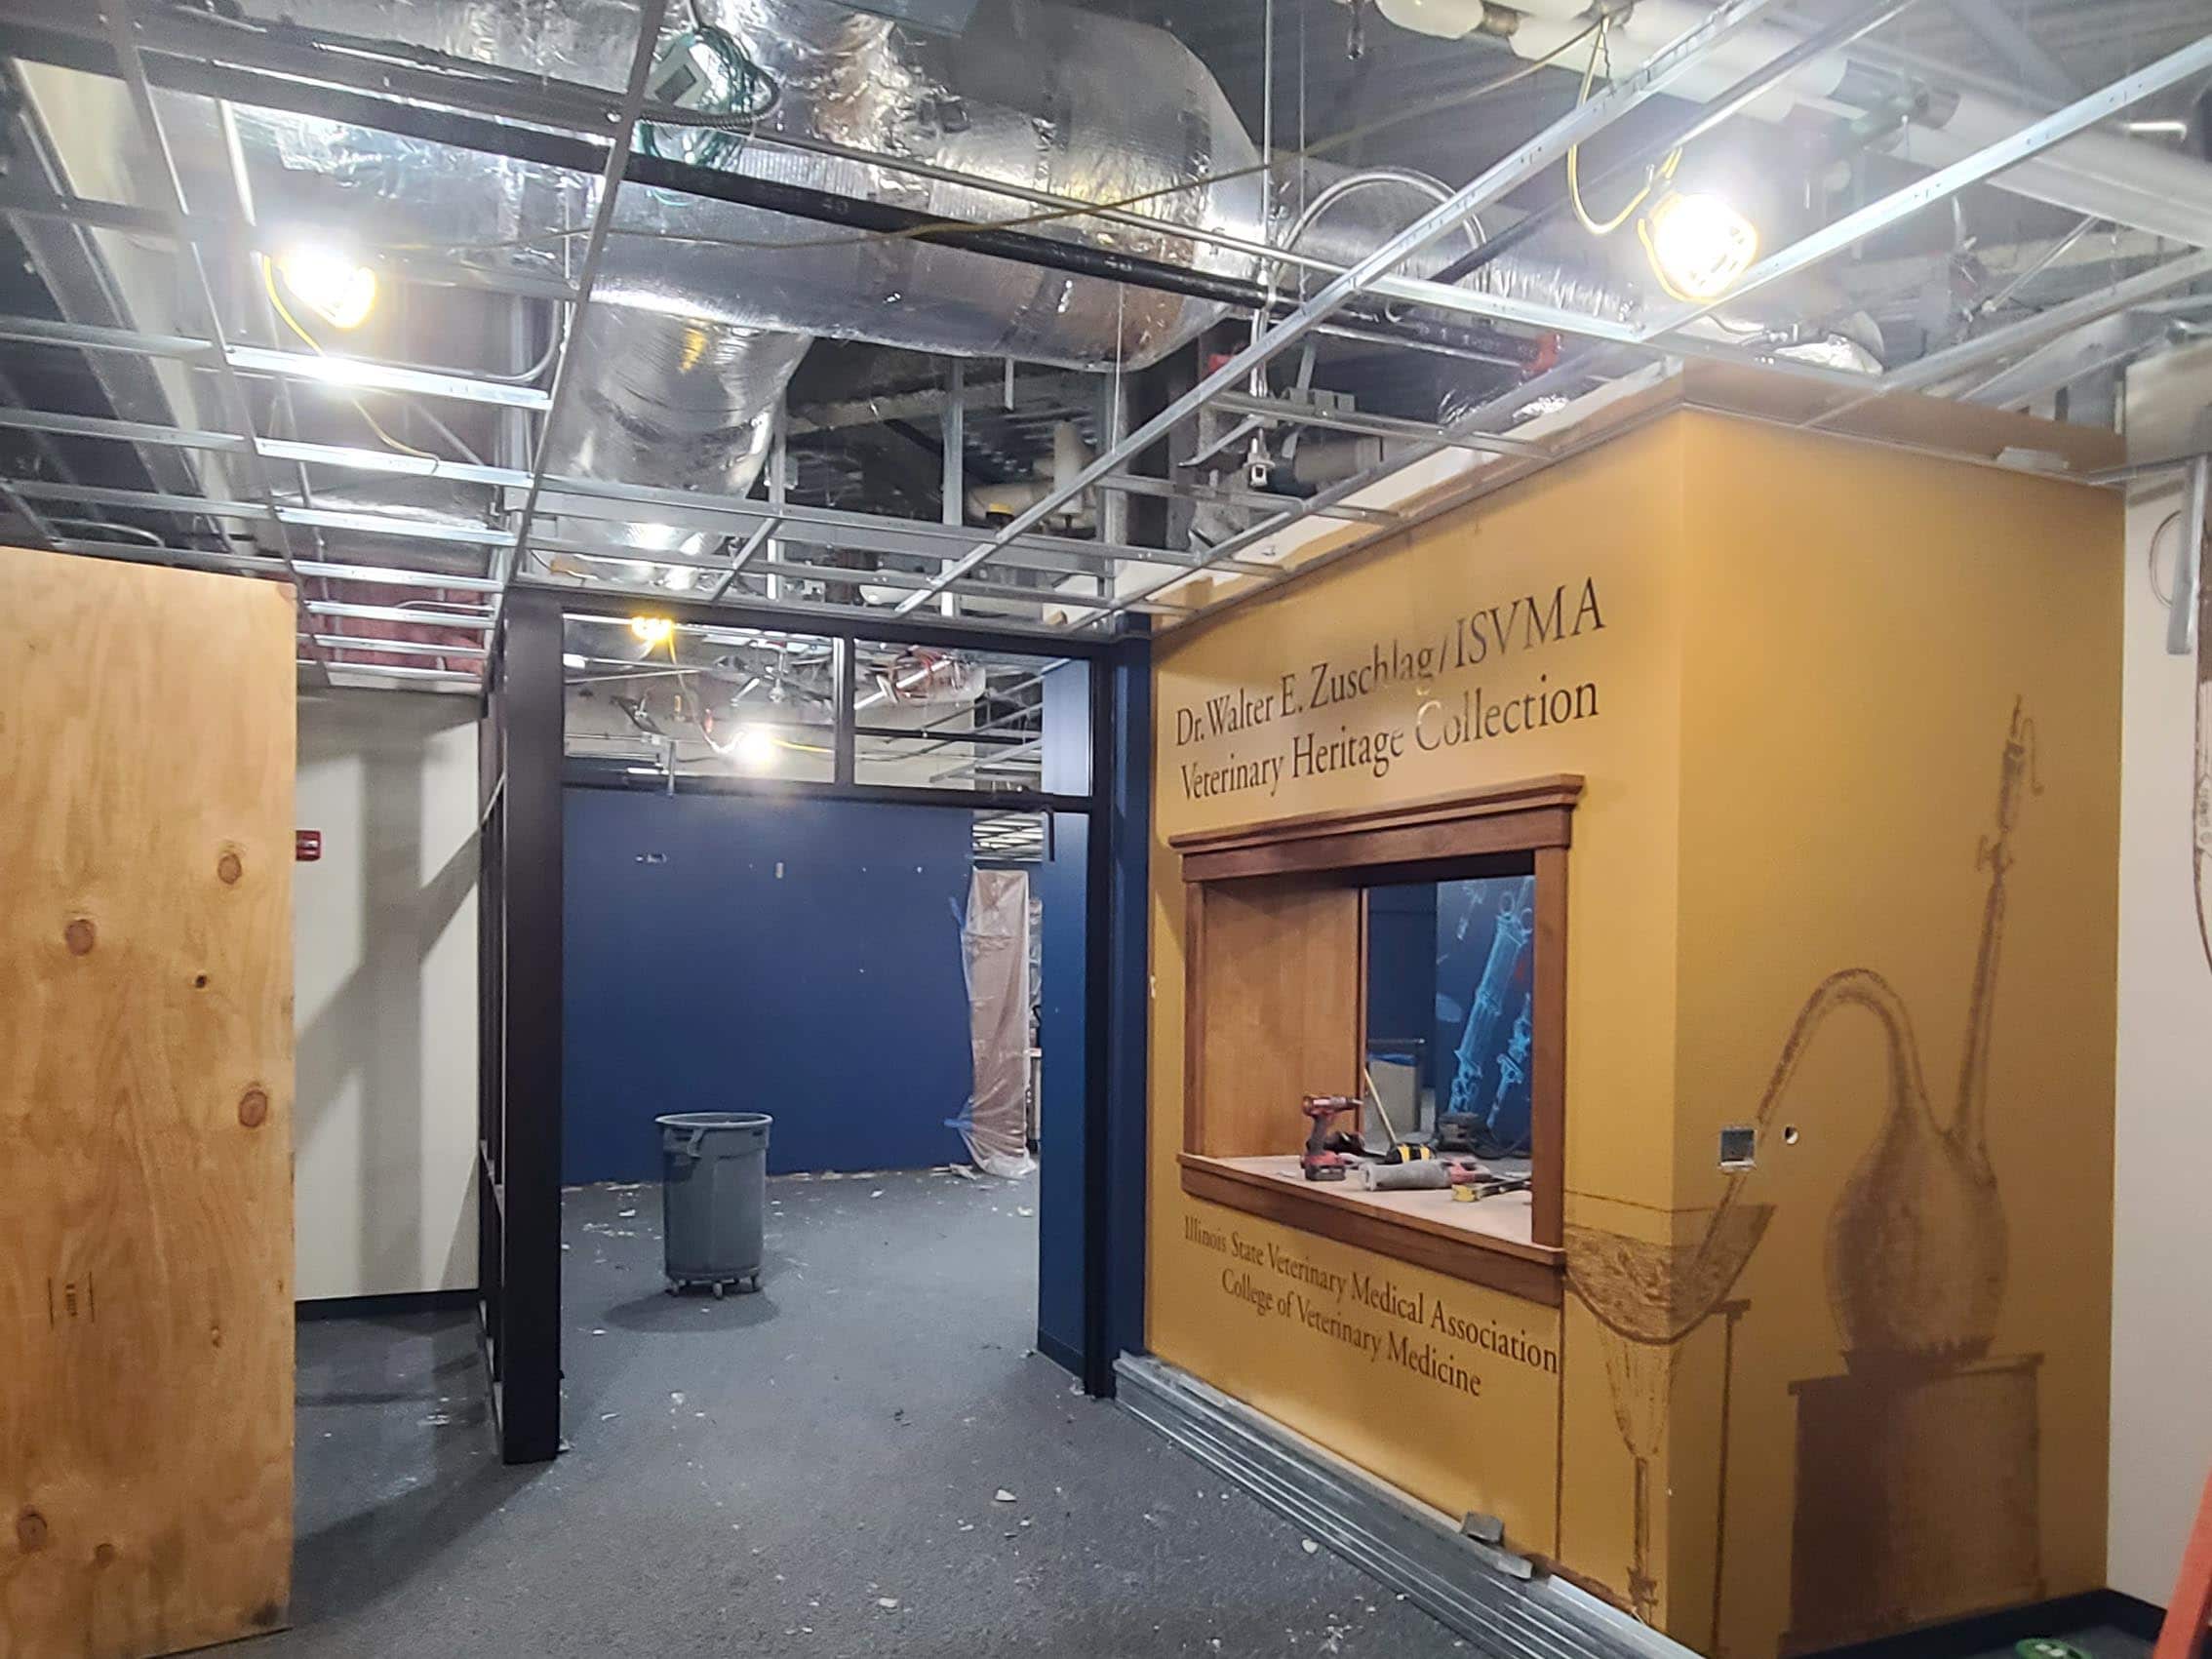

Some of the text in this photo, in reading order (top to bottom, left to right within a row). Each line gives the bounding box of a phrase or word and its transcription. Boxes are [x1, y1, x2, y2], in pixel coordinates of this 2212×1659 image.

[1176, 707, 1205, 746] Dr.
[1205, 688, 1275, 737] Walter
[1280, 673, 1303, 717] E.
[1181, 673, 1600, 801] Veterinary Heritage Collection
[1185, 1214, 1559, 1374] Illinois State Veterinary Medical Association
[1222, 1268, 1482, 1397] College of Veterinary Medicine
